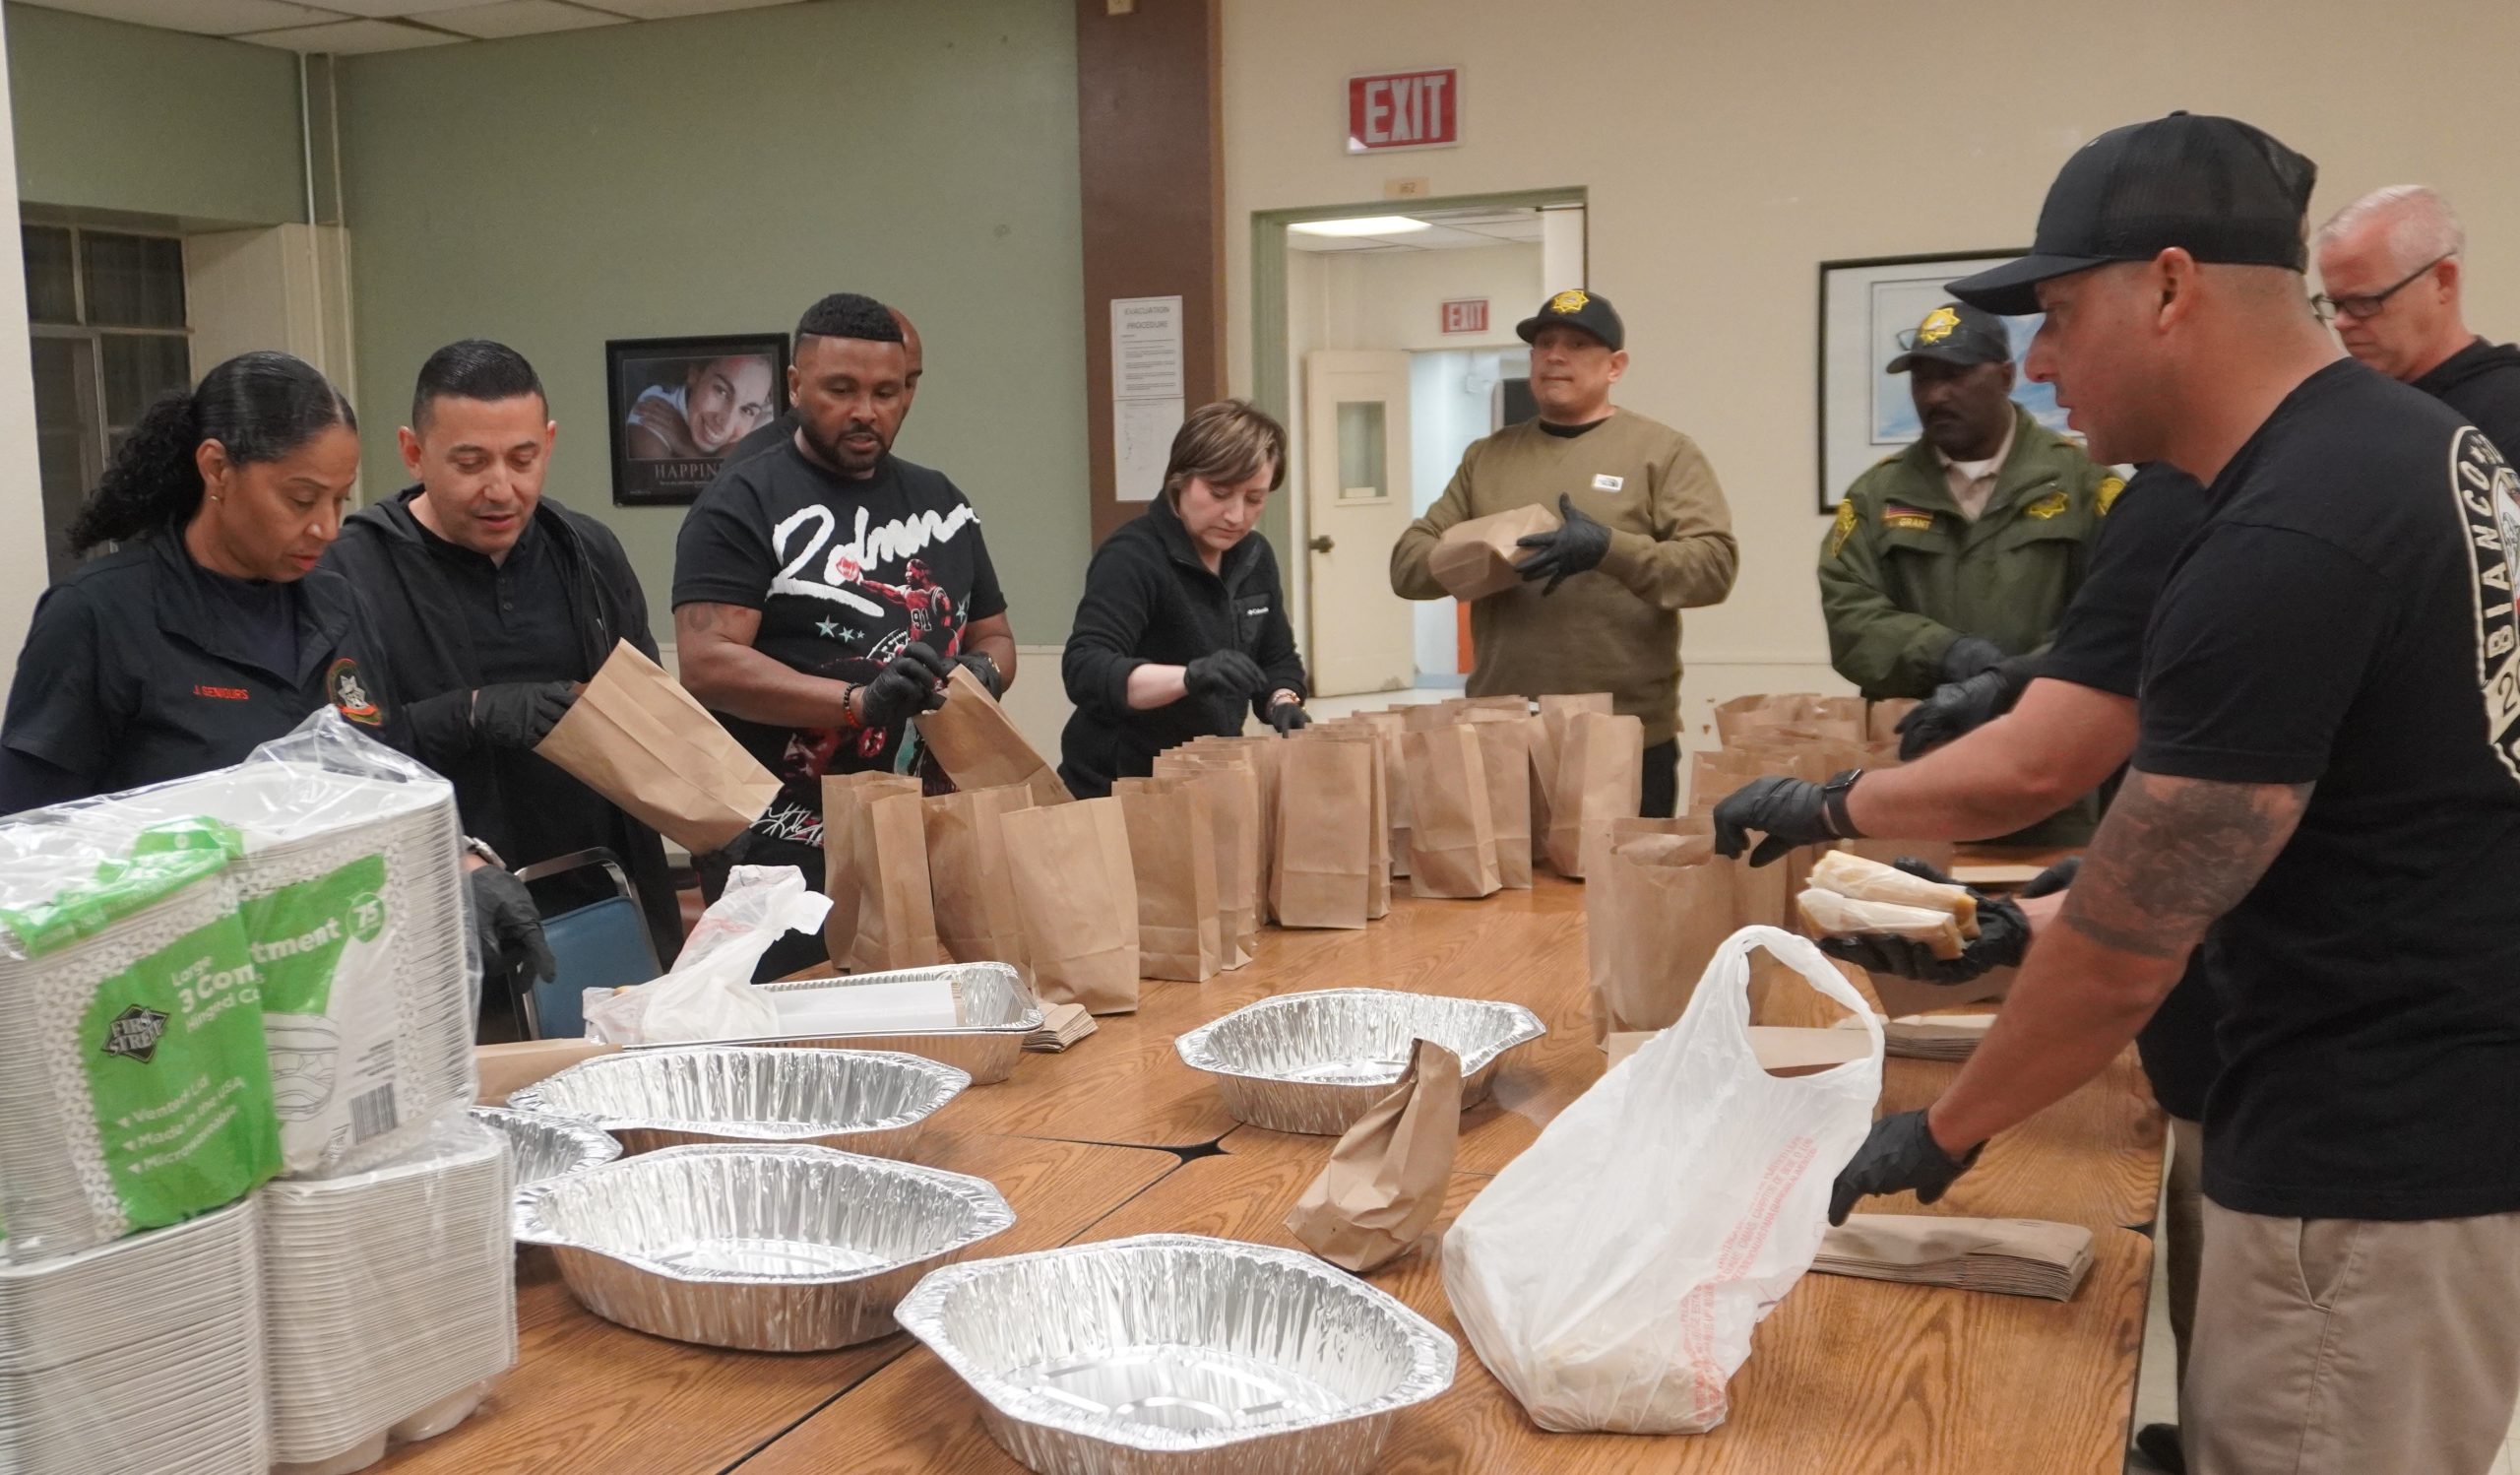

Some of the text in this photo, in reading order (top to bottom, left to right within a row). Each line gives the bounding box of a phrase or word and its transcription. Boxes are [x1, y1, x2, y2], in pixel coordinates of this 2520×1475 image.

[1365, 74, 1447, 143] EXIT
[1124, 306, 1170, 315] EVACUATION
[1449, 303, 1483, 332] EXIT
[1126, 320, 1168, 329] PROCEDURE
[655, 462, 724, 480] HAPPIN
[1899, 517, 1931, 531] GRANT
[2459, 460, 2517, 659] BIANCO
[911, 608, 932, 631] 91
[353, 900, 380, 930] 75
[178, 988, 195, 1014] 3
[138, 1123, 184, 1148] Made
